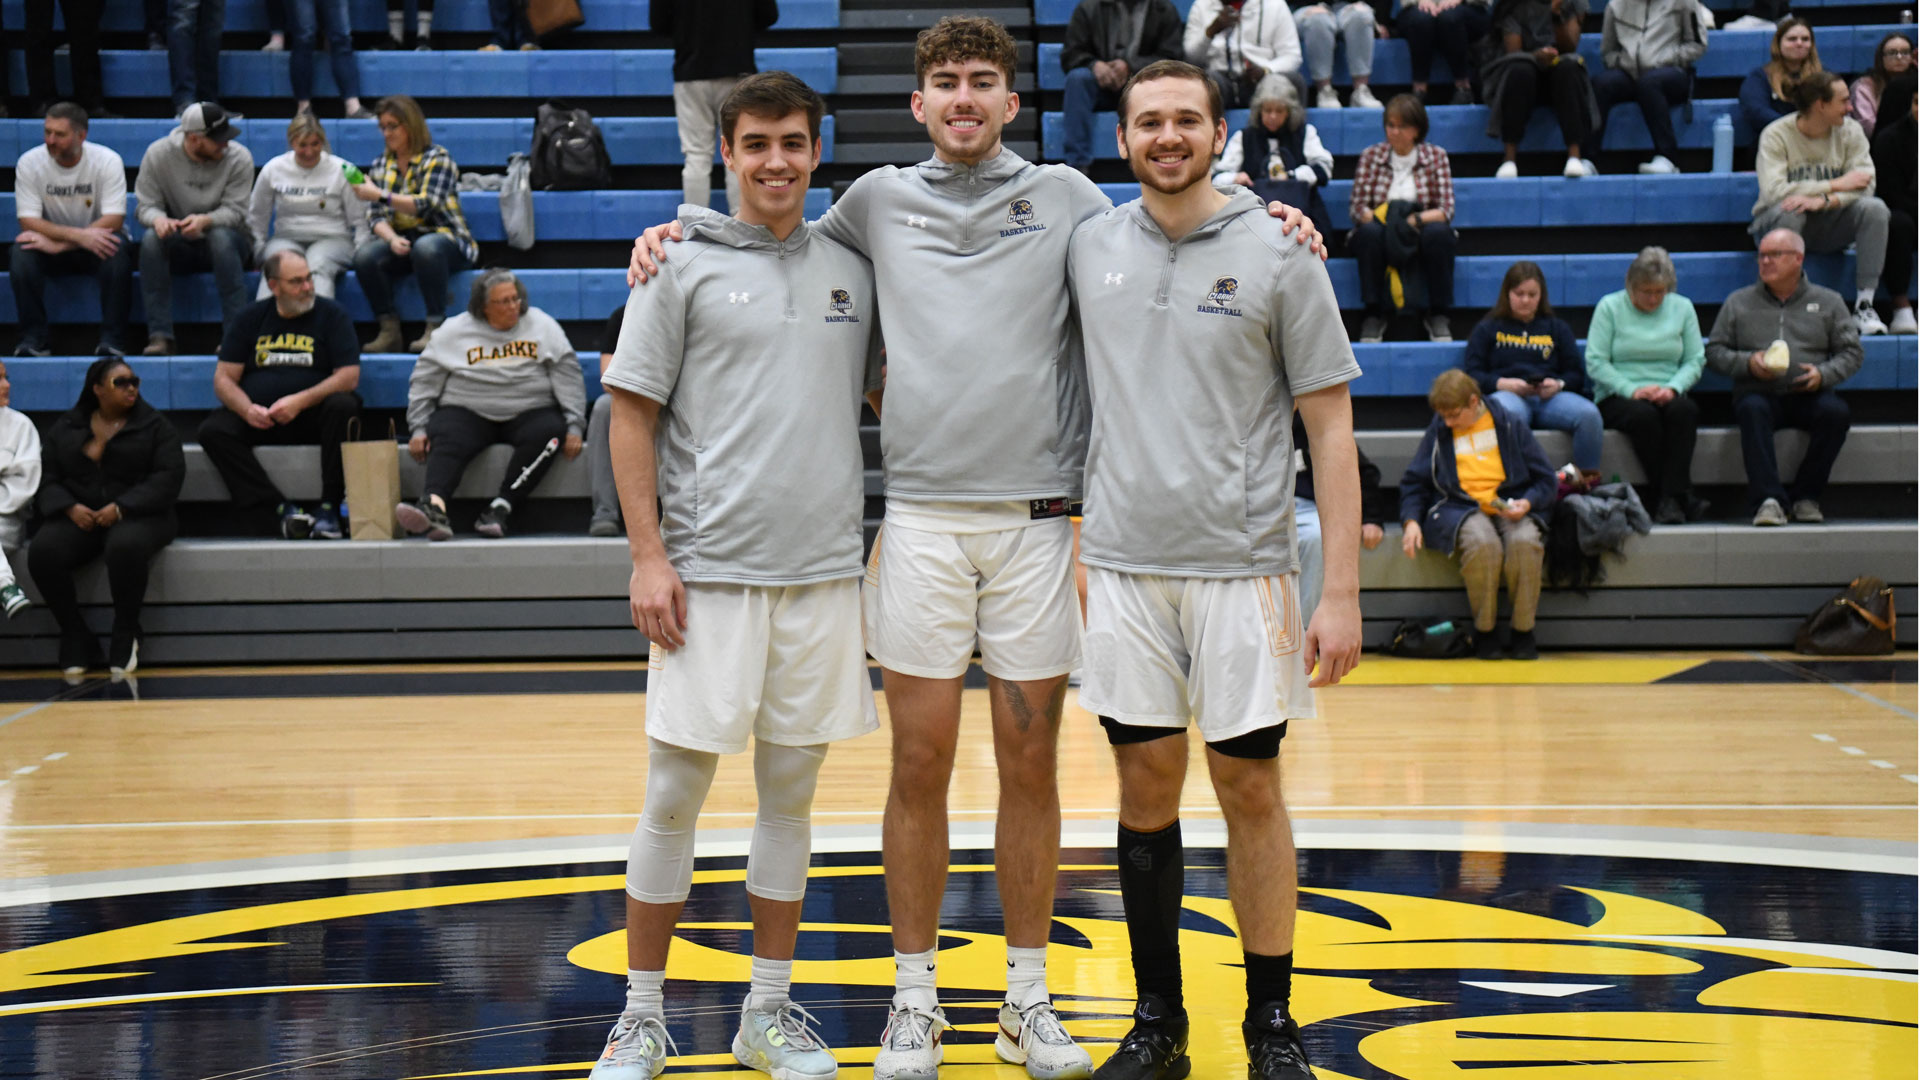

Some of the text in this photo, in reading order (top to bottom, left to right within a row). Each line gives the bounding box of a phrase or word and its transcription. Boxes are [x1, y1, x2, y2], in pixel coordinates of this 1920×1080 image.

[1007, 212, 1033, 223] CLARKE
[999, 223, 1047, 238] BASKETBALL
[1196, 304, 1242, 317] BASKETBALL
[824, 315, 860, 323] BASKETBALL
[255, 332, 315, 353] CLARKE
[467, 340, 538, 366] CLARKE
